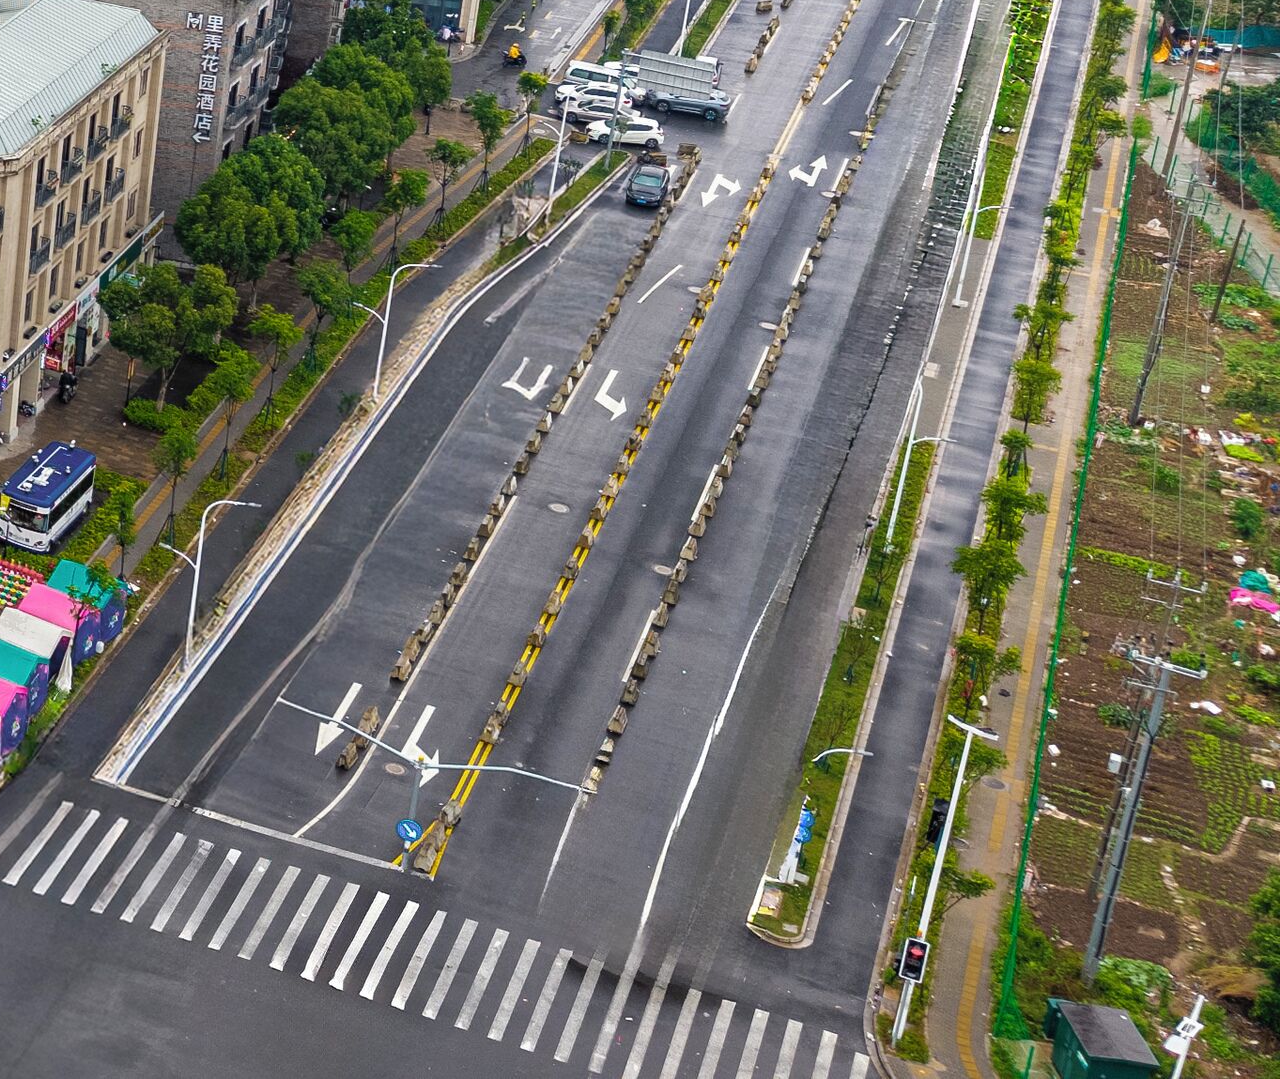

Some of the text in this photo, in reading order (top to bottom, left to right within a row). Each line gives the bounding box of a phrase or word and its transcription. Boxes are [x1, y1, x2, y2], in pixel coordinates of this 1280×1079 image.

[193, 15, 224, 131] 里弄花园酒店
